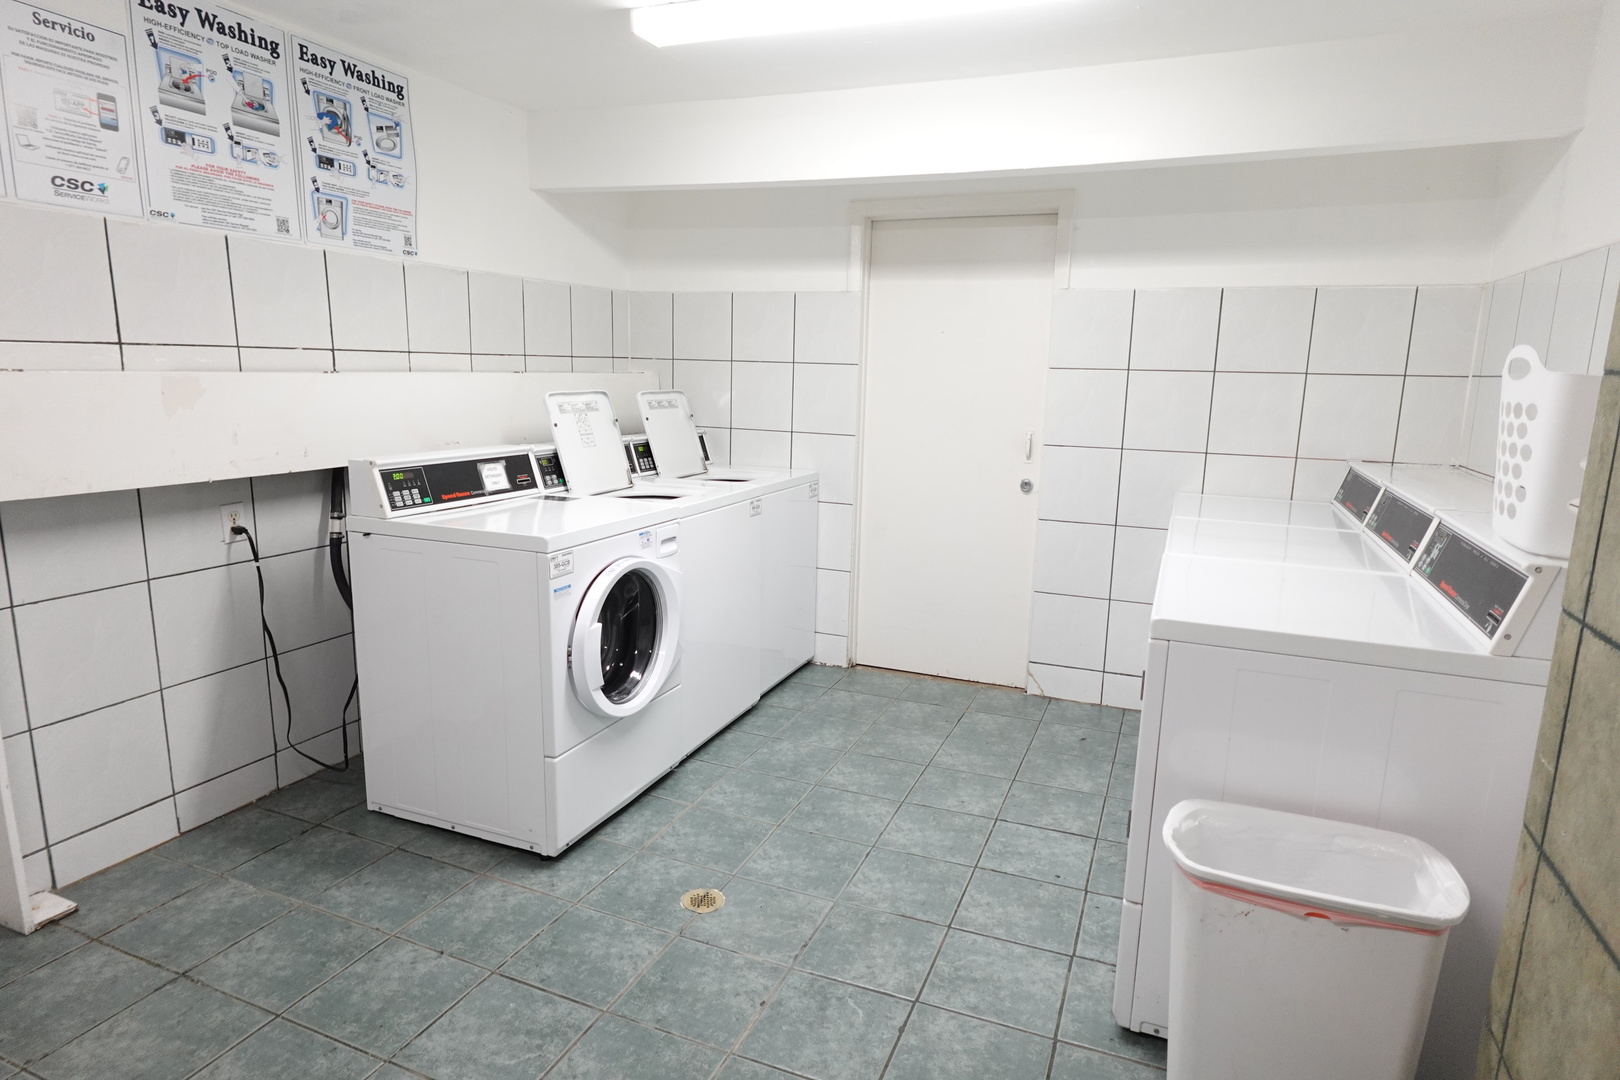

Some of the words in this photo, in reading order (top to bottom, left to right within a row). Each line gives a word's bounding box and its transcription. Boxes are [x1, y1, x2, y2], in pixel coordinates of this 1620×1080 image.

[32, 11, 95, 42] Servicio
[143, 16, 205, 43] HIGH-EFFICIENCY
[216, 41, 229, 50] TOP
[231, 46, 249, 57] LOAD
[250, 52, 277, 66] WASHER
[194, 7, 281, 59] Washing
[206, 68, 217, 76] POD
[297, 42, 337, 76] Easy
[340, 58, 405, 101] Washing
[299, 66, 345, 87] HIGH-EFFICIENCY
[353, 85, 370, 96] FRONT
[371, 91, 384, 101] LOAD
[386, 95, 405, 108] WASHER
[50, 175, 95, 193] CSC
[149, 209, 169, 219] CSC
